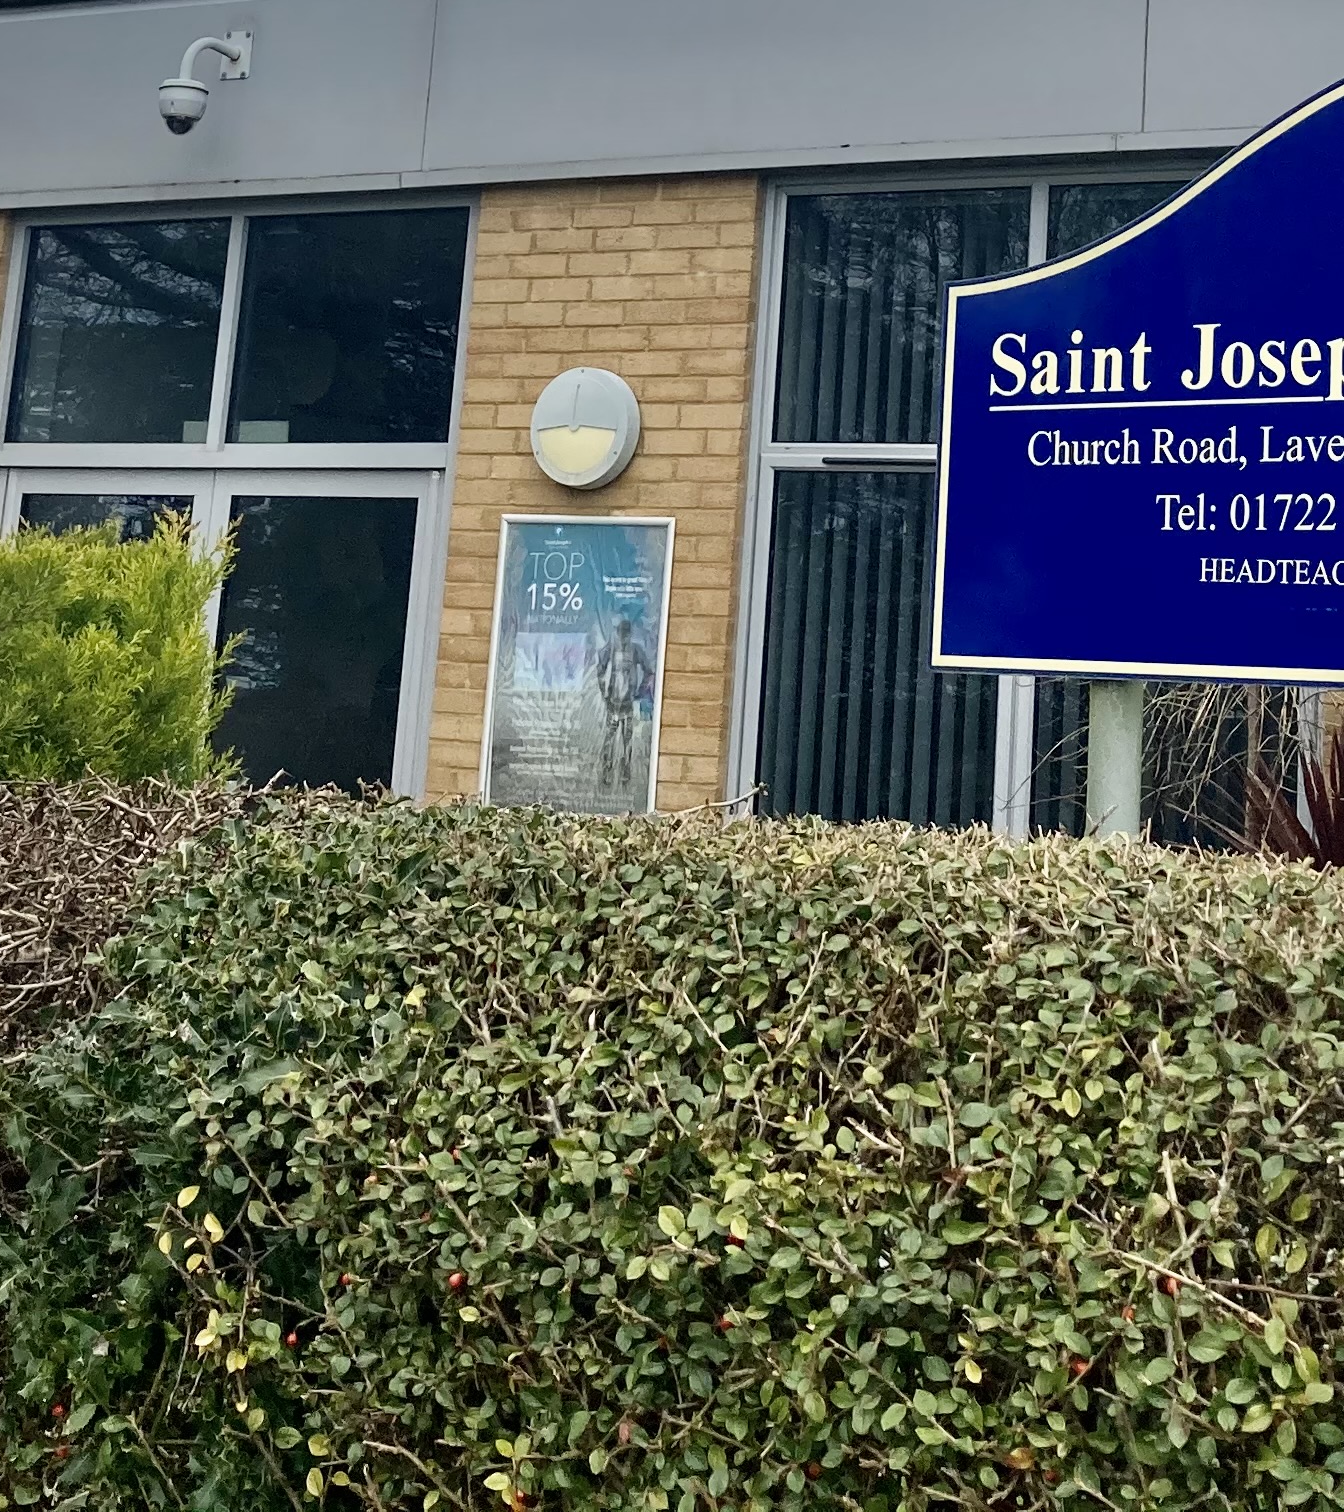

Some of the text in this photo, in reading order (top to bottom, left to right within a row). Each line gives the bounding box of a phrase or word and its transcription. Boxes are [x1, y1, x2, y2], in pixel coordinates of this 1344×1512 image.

[990, 330, 1152, 396] Saint
[1028, 428, 1140, 466] Church
[1151, 426, 1247, 470] Road,
[1156, 493, 1216, 530] Tel:
[1230, 493, 1336, 531] 01722
[530, 551, 585, 581] TOP
[527, 582, 583, 611] 15%
